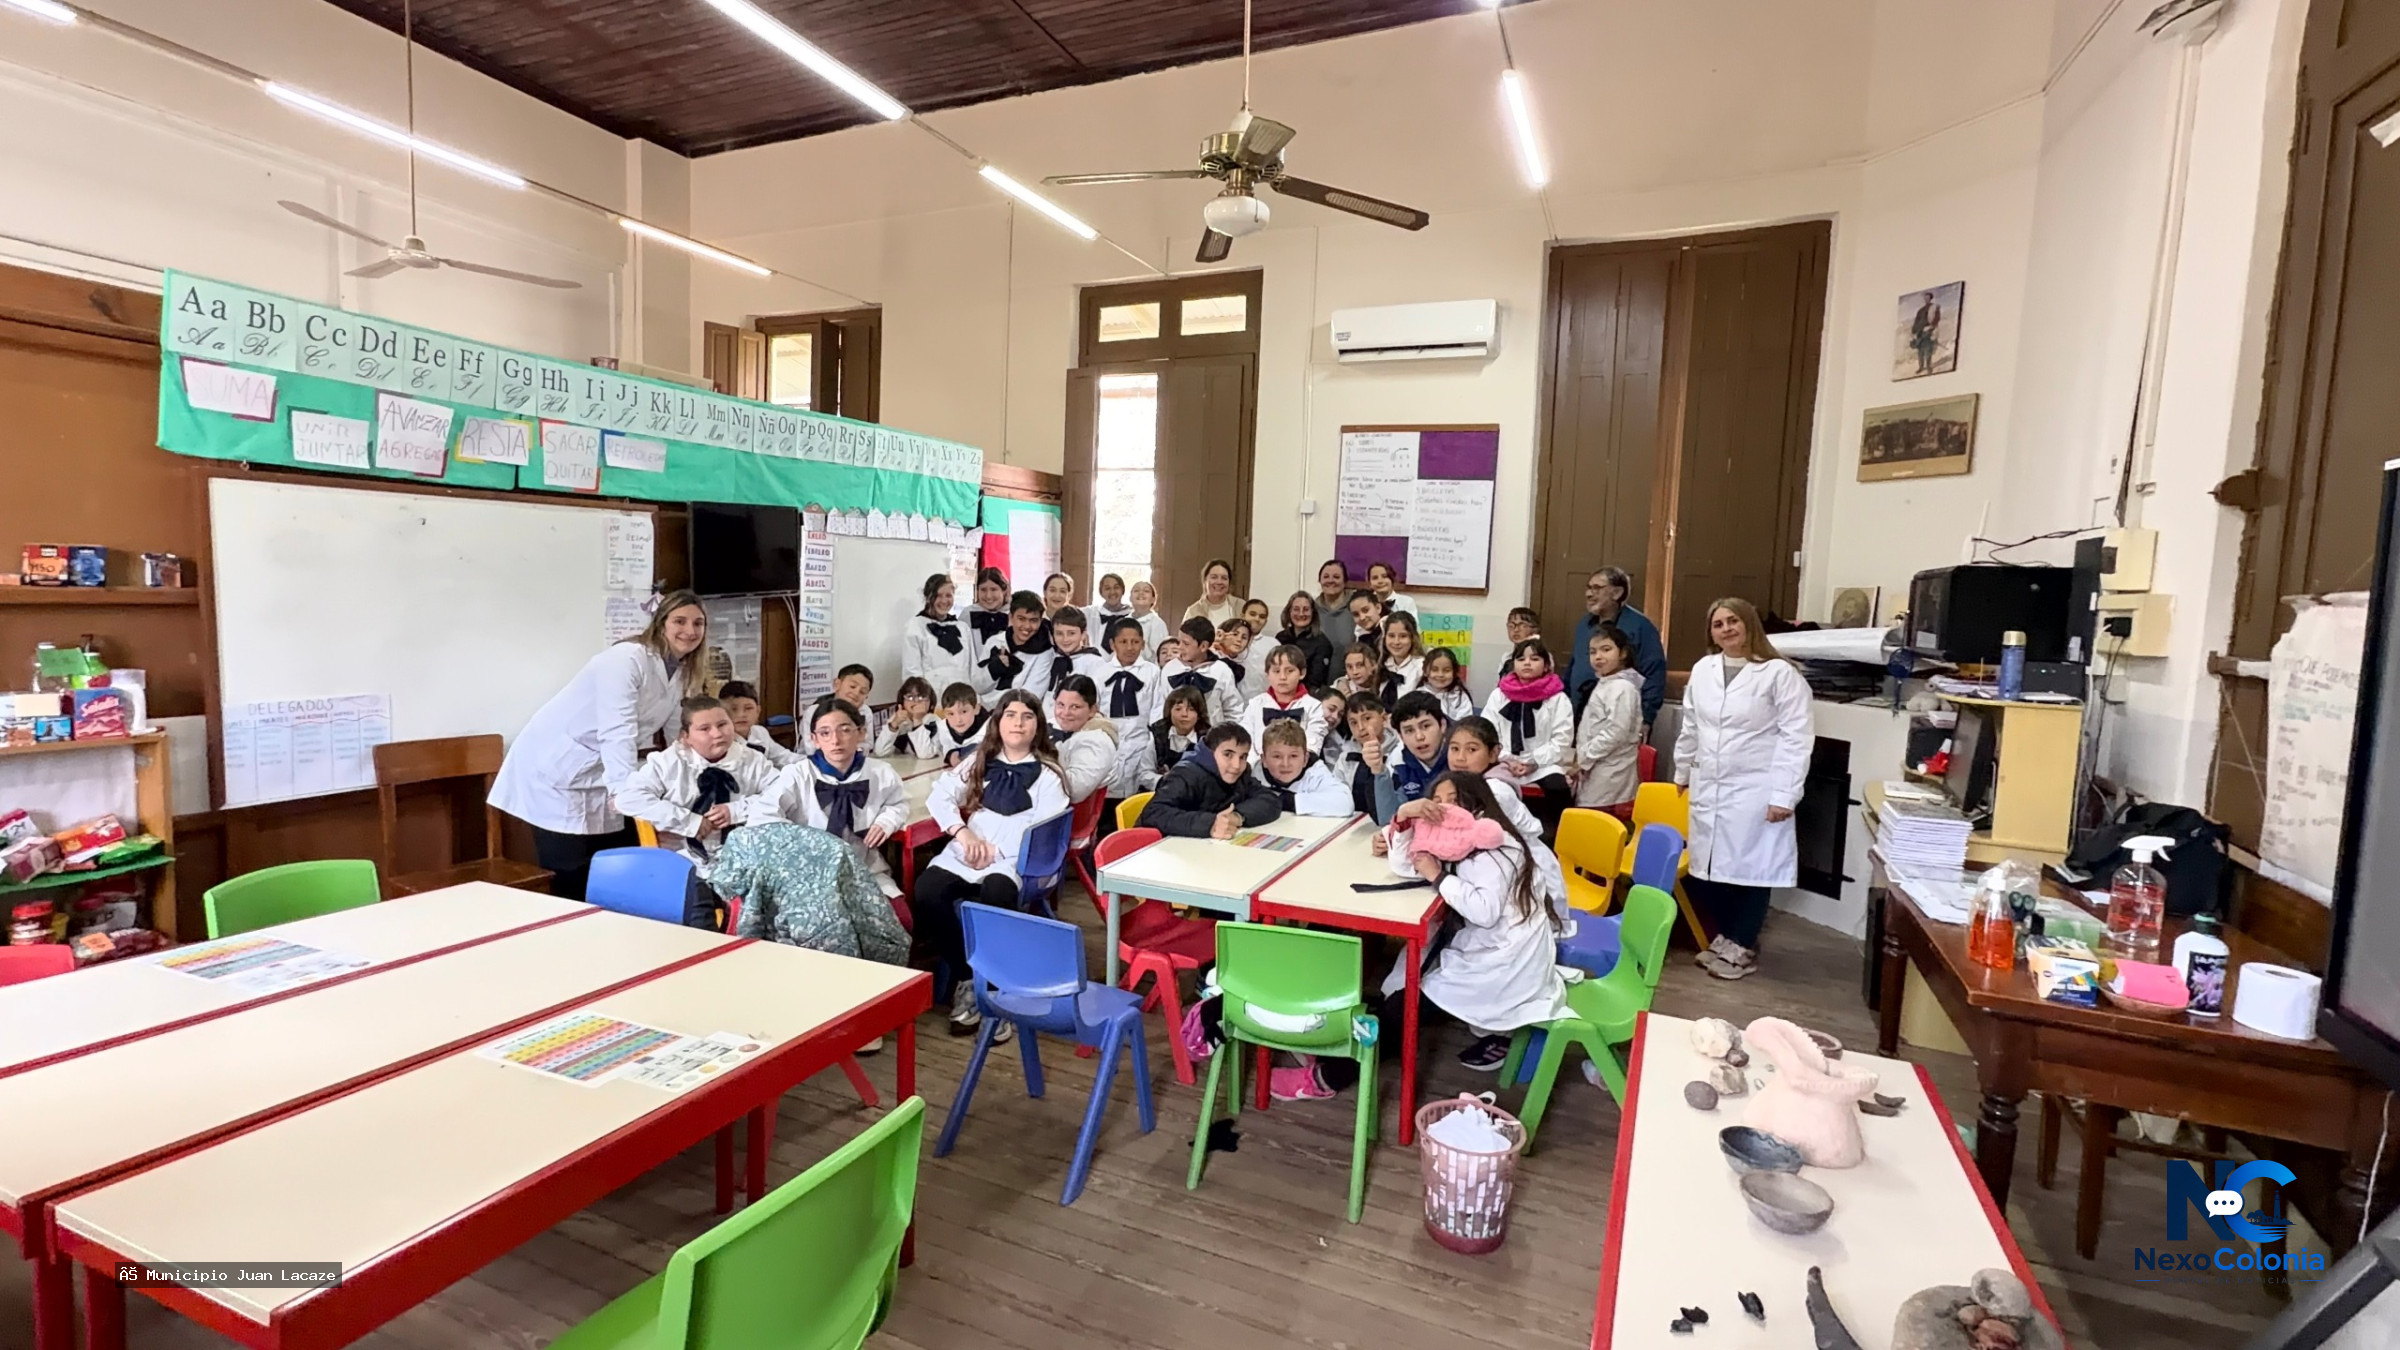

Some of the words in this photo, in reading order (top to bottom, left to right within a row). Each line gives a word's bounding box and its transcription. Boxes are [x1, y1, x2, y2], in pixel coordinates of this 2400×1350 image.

[246, 300, 286, 334] Bb
[359, 325, 398, 358] Dd
[411, 336, 446, 367] Ee
[459, 349, 485, 374] Ff
[503, 358, 533, 386] Gg
[541, 368, 569, 393] Hh
[650, 391, 671, 414] Kk
[707, 403, 726, 422] Mm
[732, 407, 750, 428] Nn
[778, 416, 796, 436] Oo
[800, 420, 816, 439] Pp
[817, 422, 833, 441] Qq
[839, 426, 854, 444] Rr
[463, 417, 527, 458] RESTA
[545, 431, 598, 456] SACAR
[802, 639, 829, 649] AGOSTO
[248, 698, 334, 716] DELEGADOS
